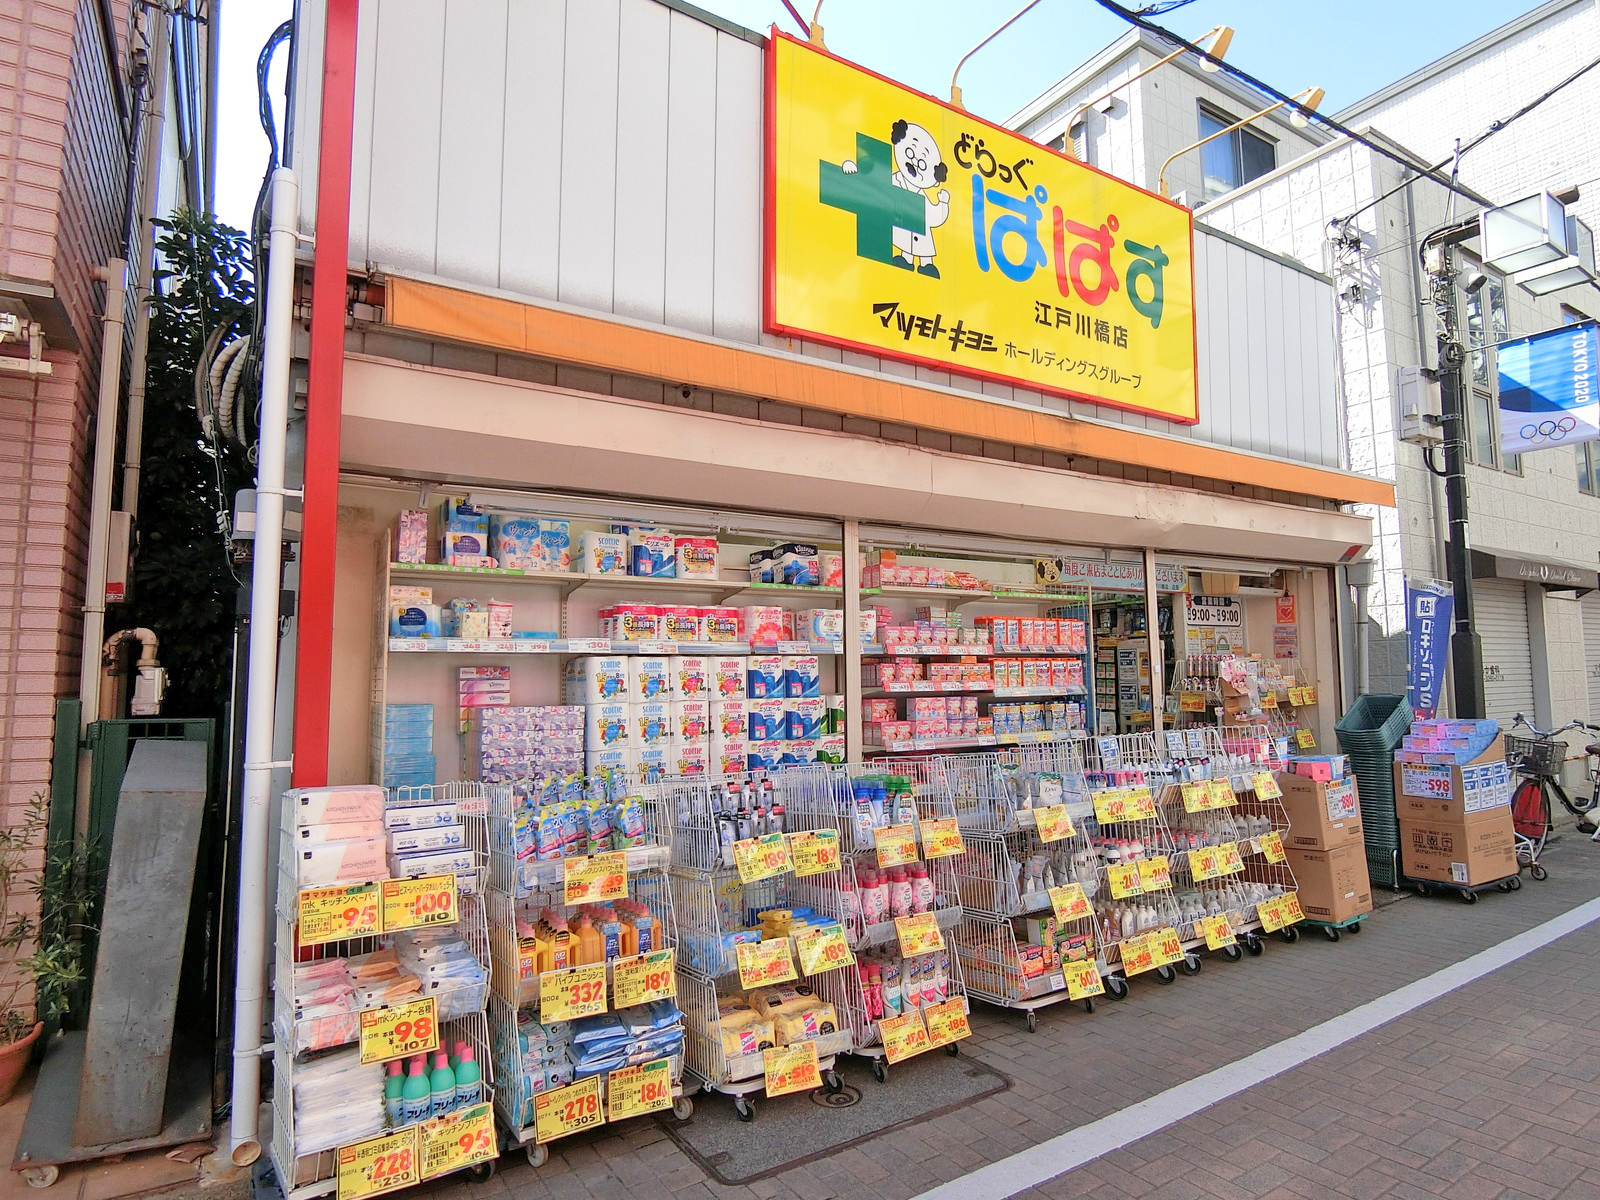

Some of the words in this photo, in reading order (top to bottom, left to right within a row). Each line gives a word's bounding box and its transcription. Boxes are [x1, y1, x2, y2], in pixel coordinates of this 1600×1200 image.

[954, 133, 1034, 190] どらっぐ
[972, 174, 1170, 330] ぱぱす
[1034, 300, 1128, 349] 江戸川橋店
[872, 302, 998, 352] マツモトキヨシ
[1004, 342, 1142, 388] ホールディングスグループ
[1572, 332, 1588, 372] TOKYO
[1574, 373, 1590, 403] 2020
[509, 525, 539, 538] ウィング
[1192, 609, 1210, 621] 9:00
[1222, 610, 1238, 622] 9:00
[1420, 620, 1432, 708] ロキソニンS
[1428, 779, 1450, 792] 598
[944, 836, 960, 846] 268
[764, 850, 786, 869] 189
[816, 847, 836, 864] 189
[1201, 856, 1216, 871] 500
[320, 894, 376, 907] キッチンペーパー
[416, 892, 451, 915] 100
[343, 905, 377, 927] 95
[424, 912, 449, 922] 110
[1215, 924, 1231, 938] 900
[825, 944, 846, 961] 189
[1162, 939, 1180, 955] 248
[555, 972, 604, 986] パイプユニッシュ
[646, 971, 670, 992] 189
[1080, 970, 1099, 987] 600
[570, 981, 603, 1005] 332
[394, 1017, 432, 1042] 98
[404, 1038, 429, 1051] 107
[564, 1094, 597, 1120] 278
[574, 1114, 596, 1126] 305
[459, 1128, 491, 1153] 95
[374, 1149, 411, 1179] 228
[383, 1172, 410, 1187] 250
